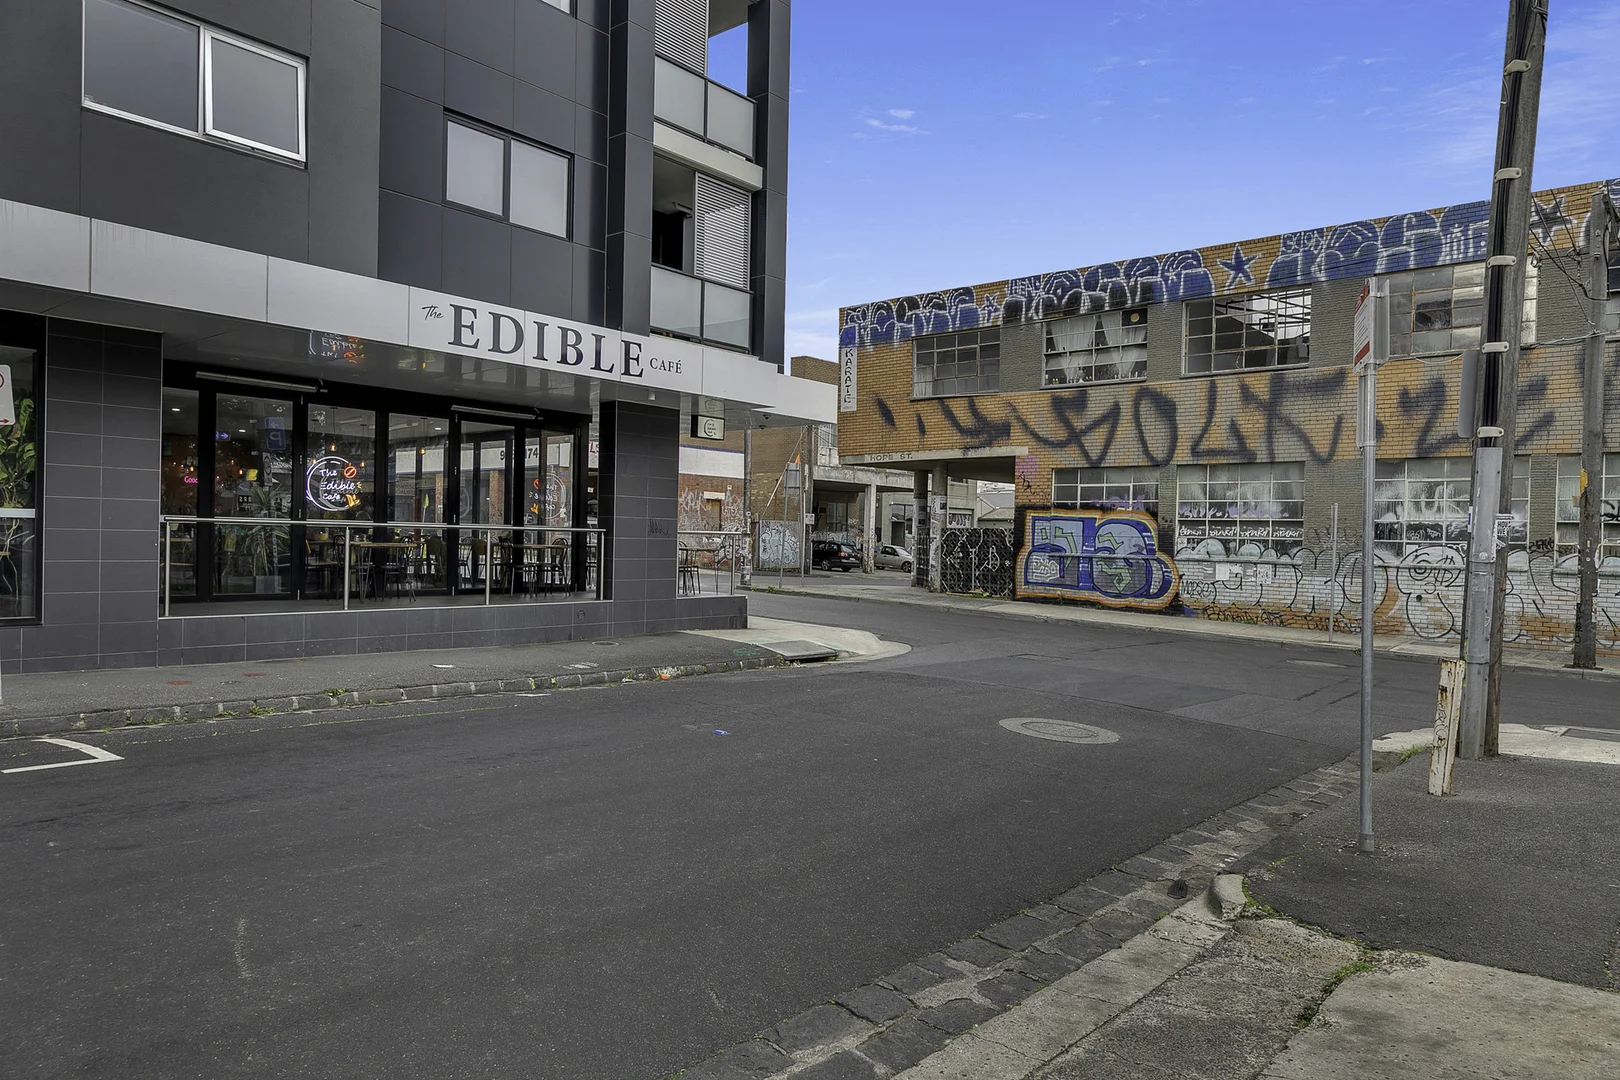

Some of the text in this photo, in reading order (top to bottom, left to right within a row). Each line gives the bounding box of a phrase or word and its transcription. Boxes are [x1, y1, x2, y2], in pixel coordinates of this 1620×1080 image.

[421, 303, 681, 378] The EDIBLE CAFÉ
[843, 349, 853, 403] KARATE
[900, 451, 913, 460] ST.
[320, 481, 355, 490] Edible
